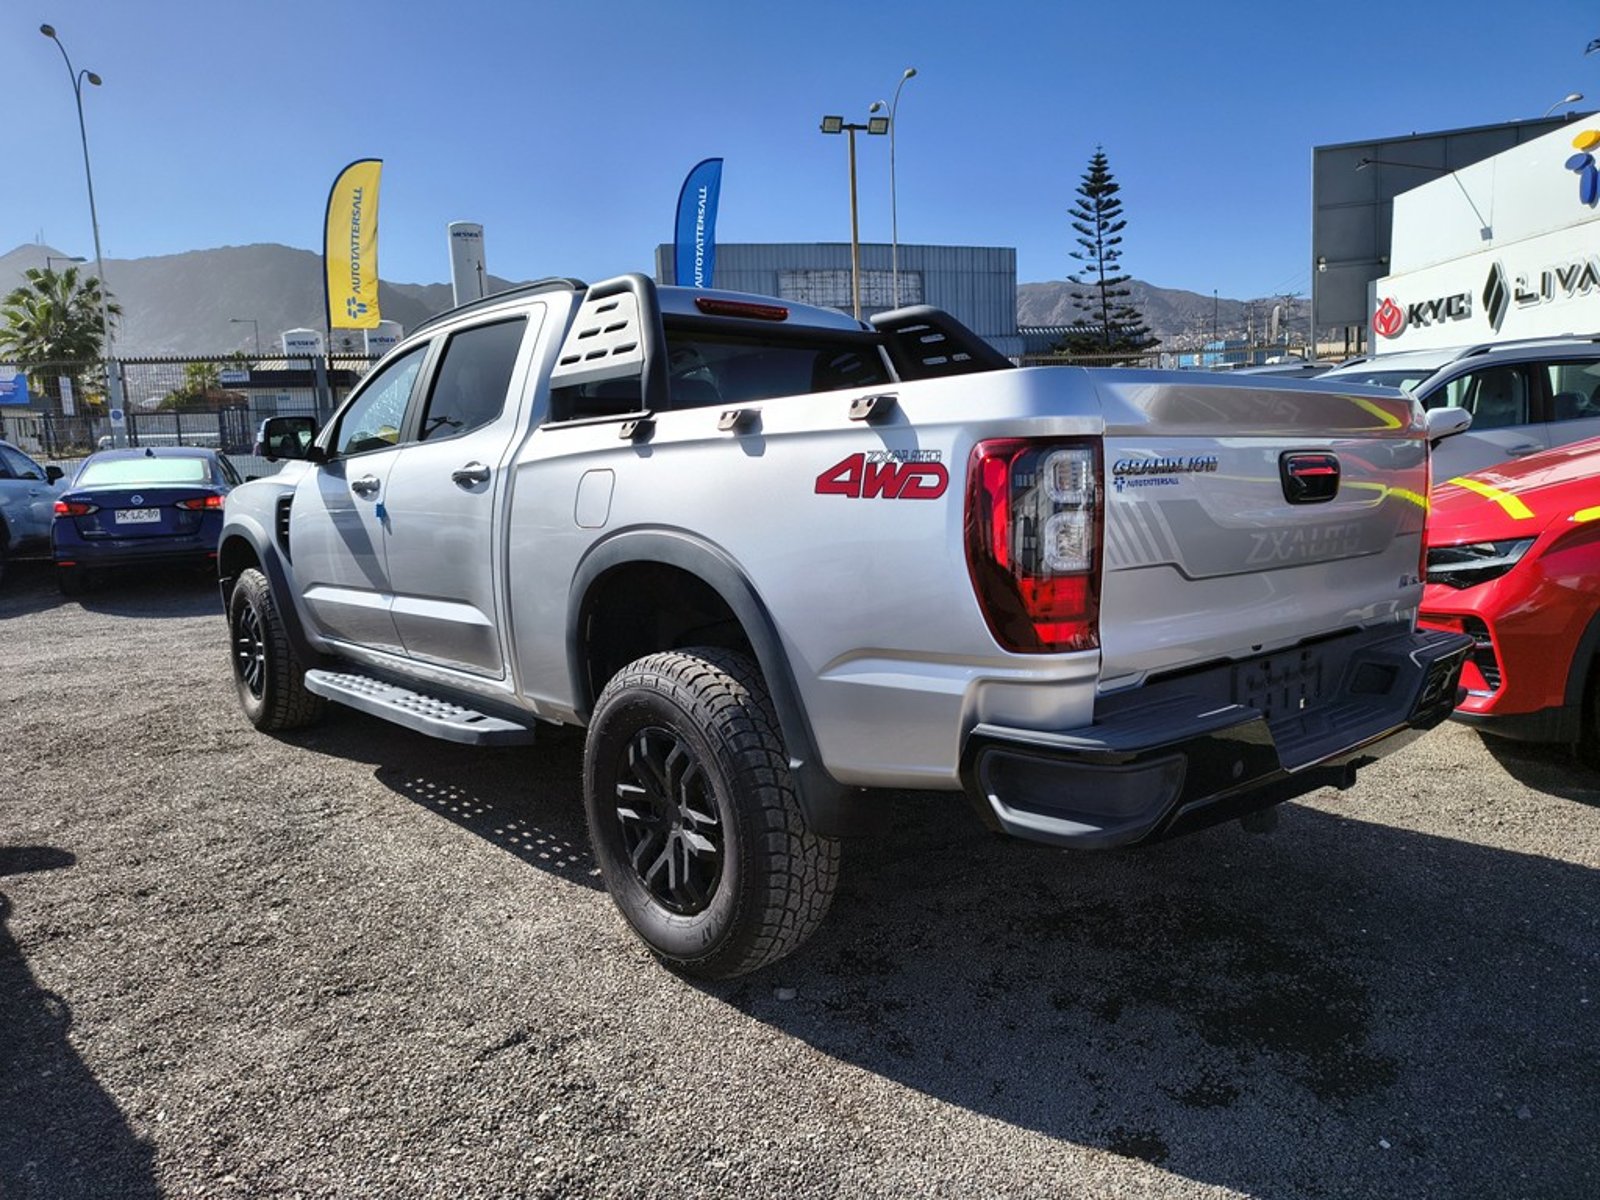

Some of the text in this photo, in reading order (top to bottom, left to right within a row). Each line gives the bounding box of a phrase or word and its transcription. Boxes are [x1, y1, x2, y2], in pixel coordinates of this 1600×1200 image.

[351, 186, 363, 295] AUTOTATTERSALL
[694, 185, 707, 289] AUTOTATTERSALL
[1408, 291, 1472, 328] KYC
[815, 452, 949, 499] 4WD
[866, 449, 942, 463] ZXAUTO
[1246, 523, 1361, 564] ZXAUTO
